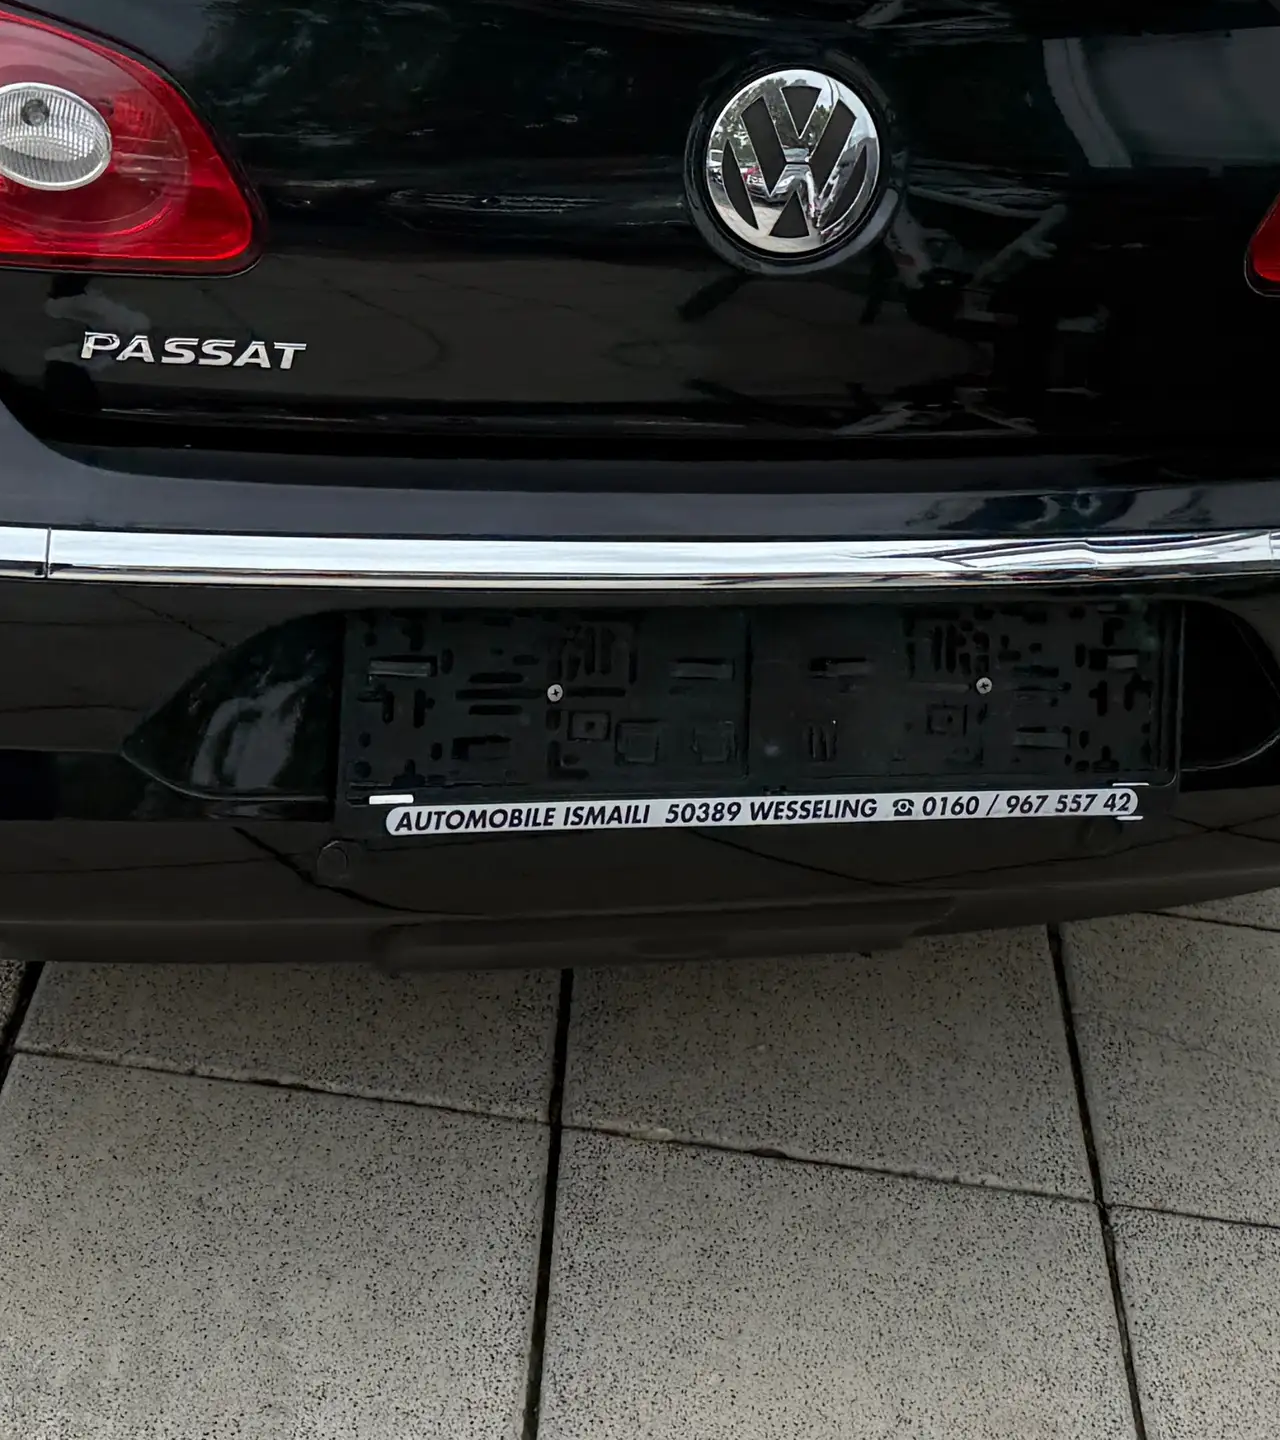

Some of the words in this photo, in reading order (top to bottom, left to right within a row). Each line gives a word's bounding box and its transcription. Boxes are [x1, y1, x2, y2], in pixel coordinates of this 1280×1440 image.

[80, 331, 308, 370] PASSAT
[394, 807, 556, 832] AUTOMOBILE
[563, 804, 650, 826] ISMAILI
[665, 801, 742, 823] 50389
[749, 798, 877, 821] WESSELING
[922, 795, 980, 816] 0160
[986, 793, 1000, 816] /
[1006, 794, 1049, 814] 967
[1055, 793, 1098, 813] 557
[1103, 792, 1131, 812] 42
